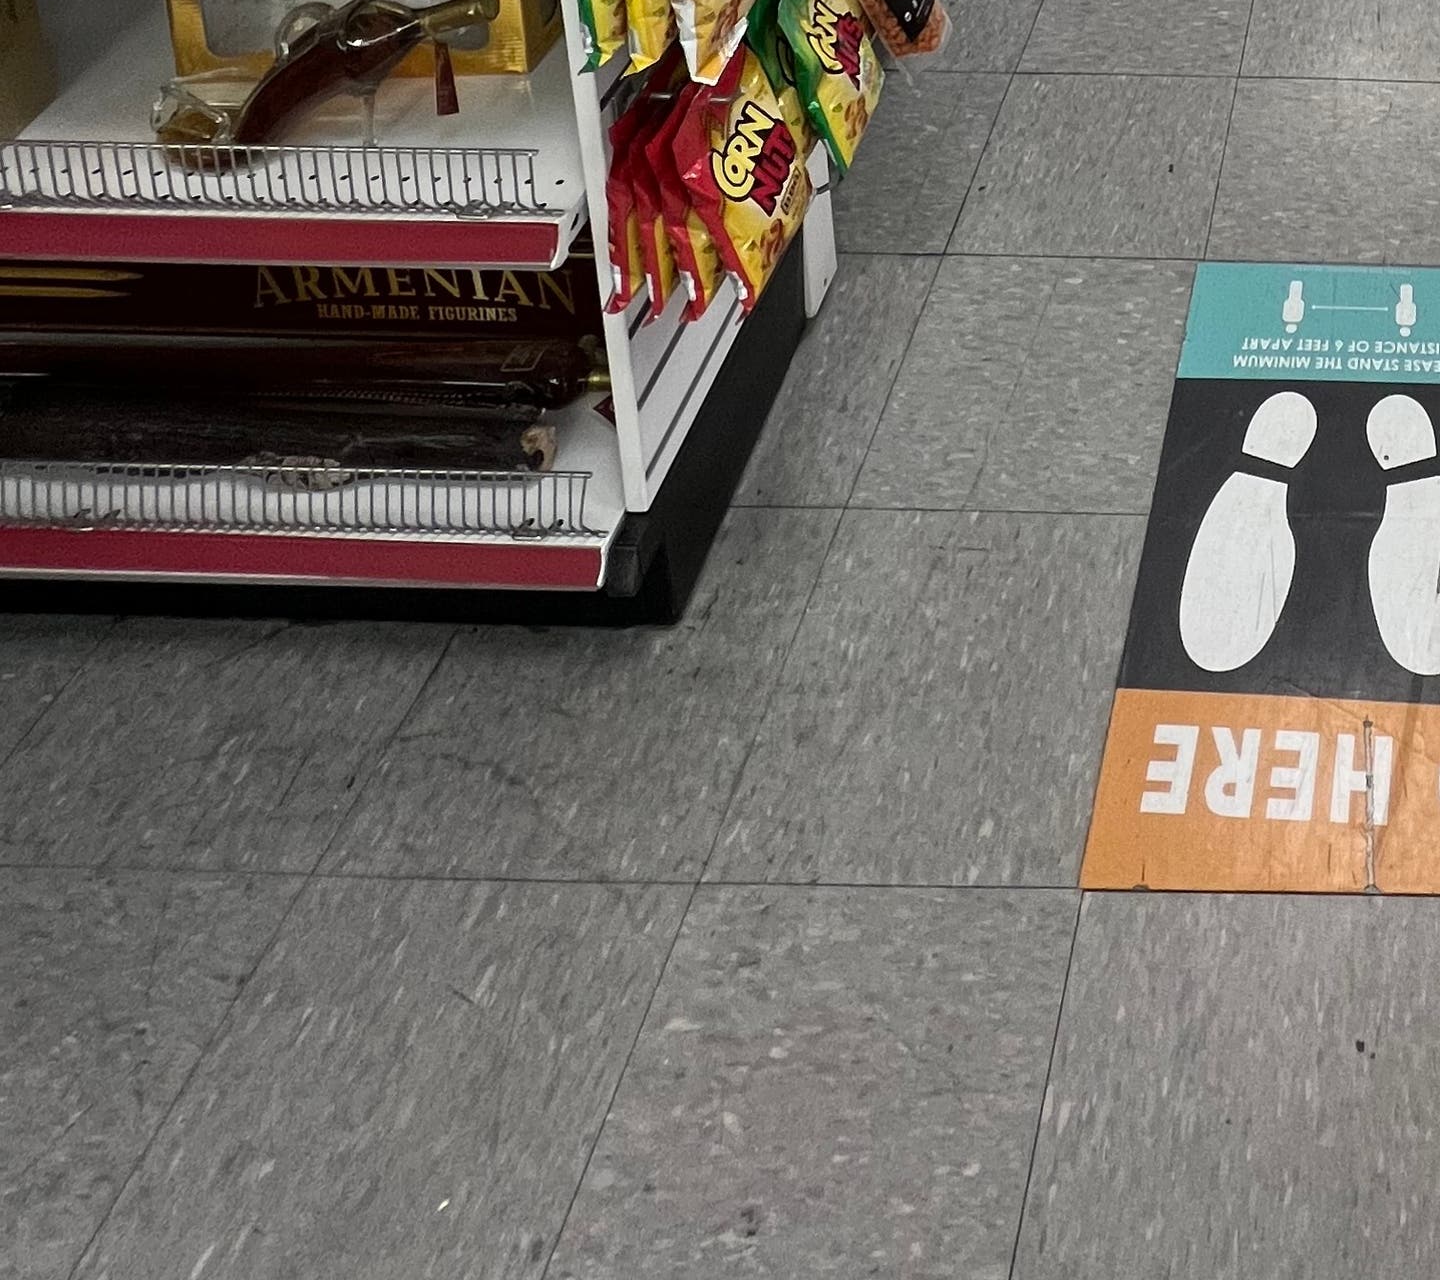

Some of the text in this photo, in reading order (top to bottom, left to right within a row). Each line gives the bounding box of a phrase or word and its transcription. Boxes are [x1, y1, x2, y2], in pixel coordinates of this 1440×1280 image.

[709, 100, 777, 203] CORN
[252, 265, 577, 315] ARMENIAN
[317, 303, 518, 324] HAND-MADE FIGURINES
[1241, 336, 1293, 351] APART
[1296, 338, 1330, 352] FEET
[1334, 339, 1342, 352] 6
[1347, 340, 1370, 354] OF
[1233, 354, 1311, 369] MINIMUM
[1315, 356, 1343, 370] THE
[1347, 357, 1399, 372] STAND
[1137, 722, 1396, 827] HERE
